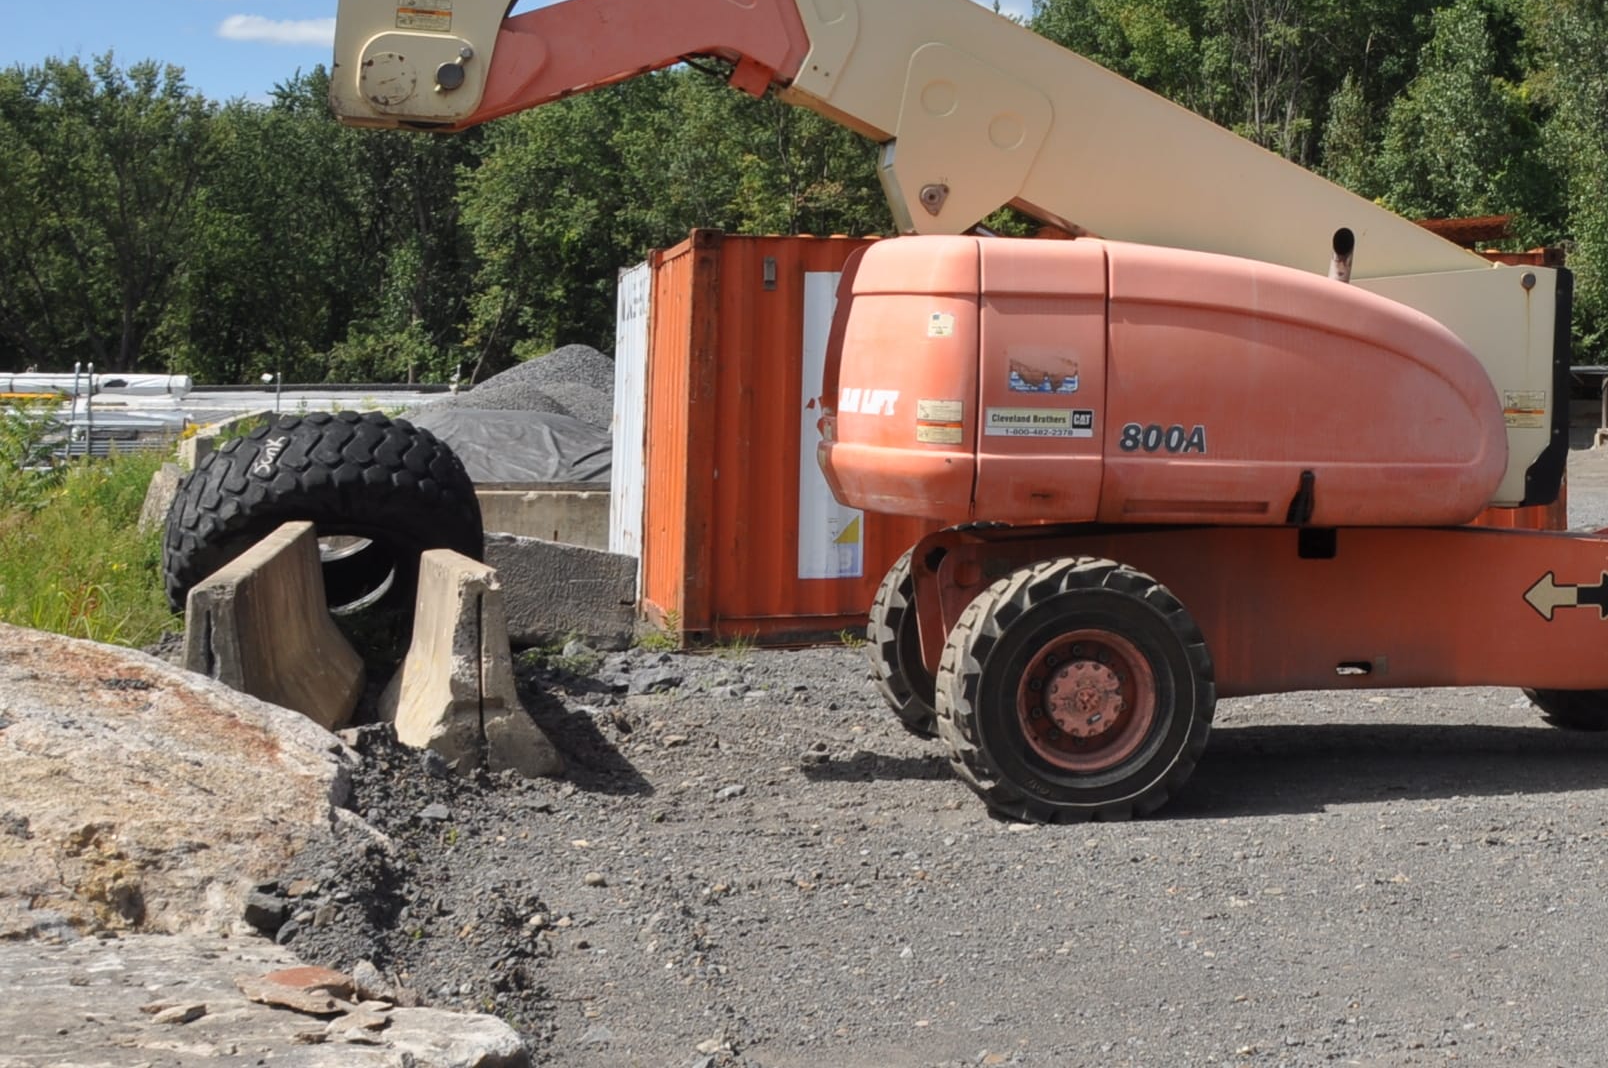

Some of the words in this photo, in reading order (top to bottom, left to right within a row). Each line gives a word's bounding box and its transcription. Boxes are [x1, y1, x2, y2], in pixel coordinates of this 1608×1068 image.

[991, 413, 1031, 424] Cleveland
[1032, 414, 1067, 424] Brothers
[1073, 413, 1091, 426] CAT
[1119, 423, 1206, 454] 800A
